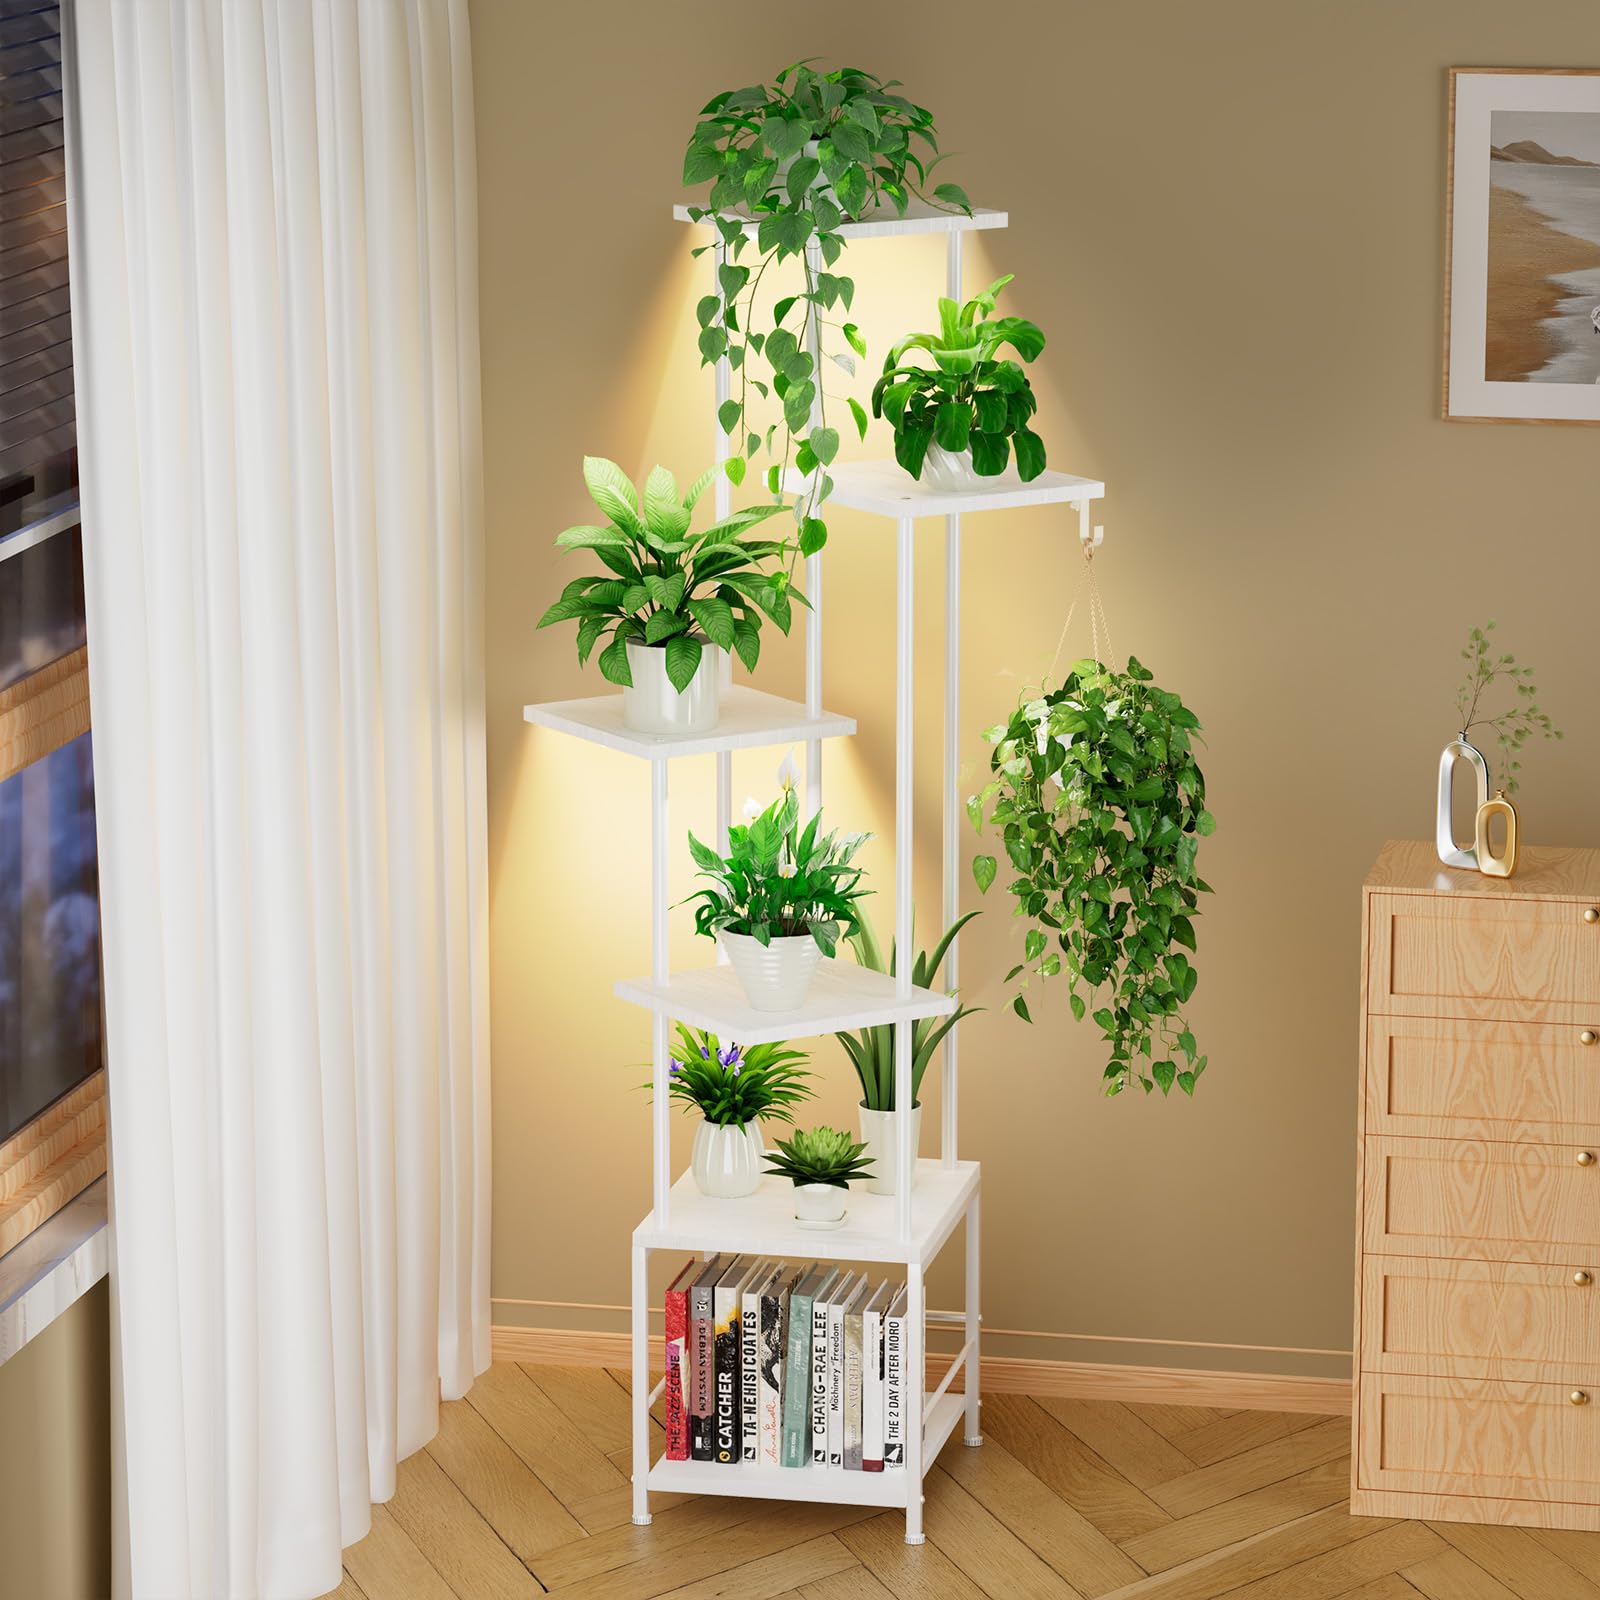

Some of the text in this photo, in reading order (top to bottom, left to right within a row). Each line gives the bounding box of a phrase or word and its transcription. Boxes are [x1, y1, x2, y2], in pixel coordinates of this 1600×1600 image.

[698, 1327, 706, 1366] DEBIAN
[831, 1323, 839, 1361] Freedom
[889, 1321, 899, 1351] MORO
[743, 1311, 756, 1437] TA-NEHISI COATES
[813, 1312, 826, 1434] CHANG-RAE LEE
[889, 1354, 899, 1386] AFTER
[671, 1355, 680, 1451] THE JAZZ SCENE
[831, 1369, 840, 1411] Machinery
[889, 1389, 899, 1408] DAY
[718, 1372, 732, 1448] CATCHER
[889, 1420, 899, 1439] THE
